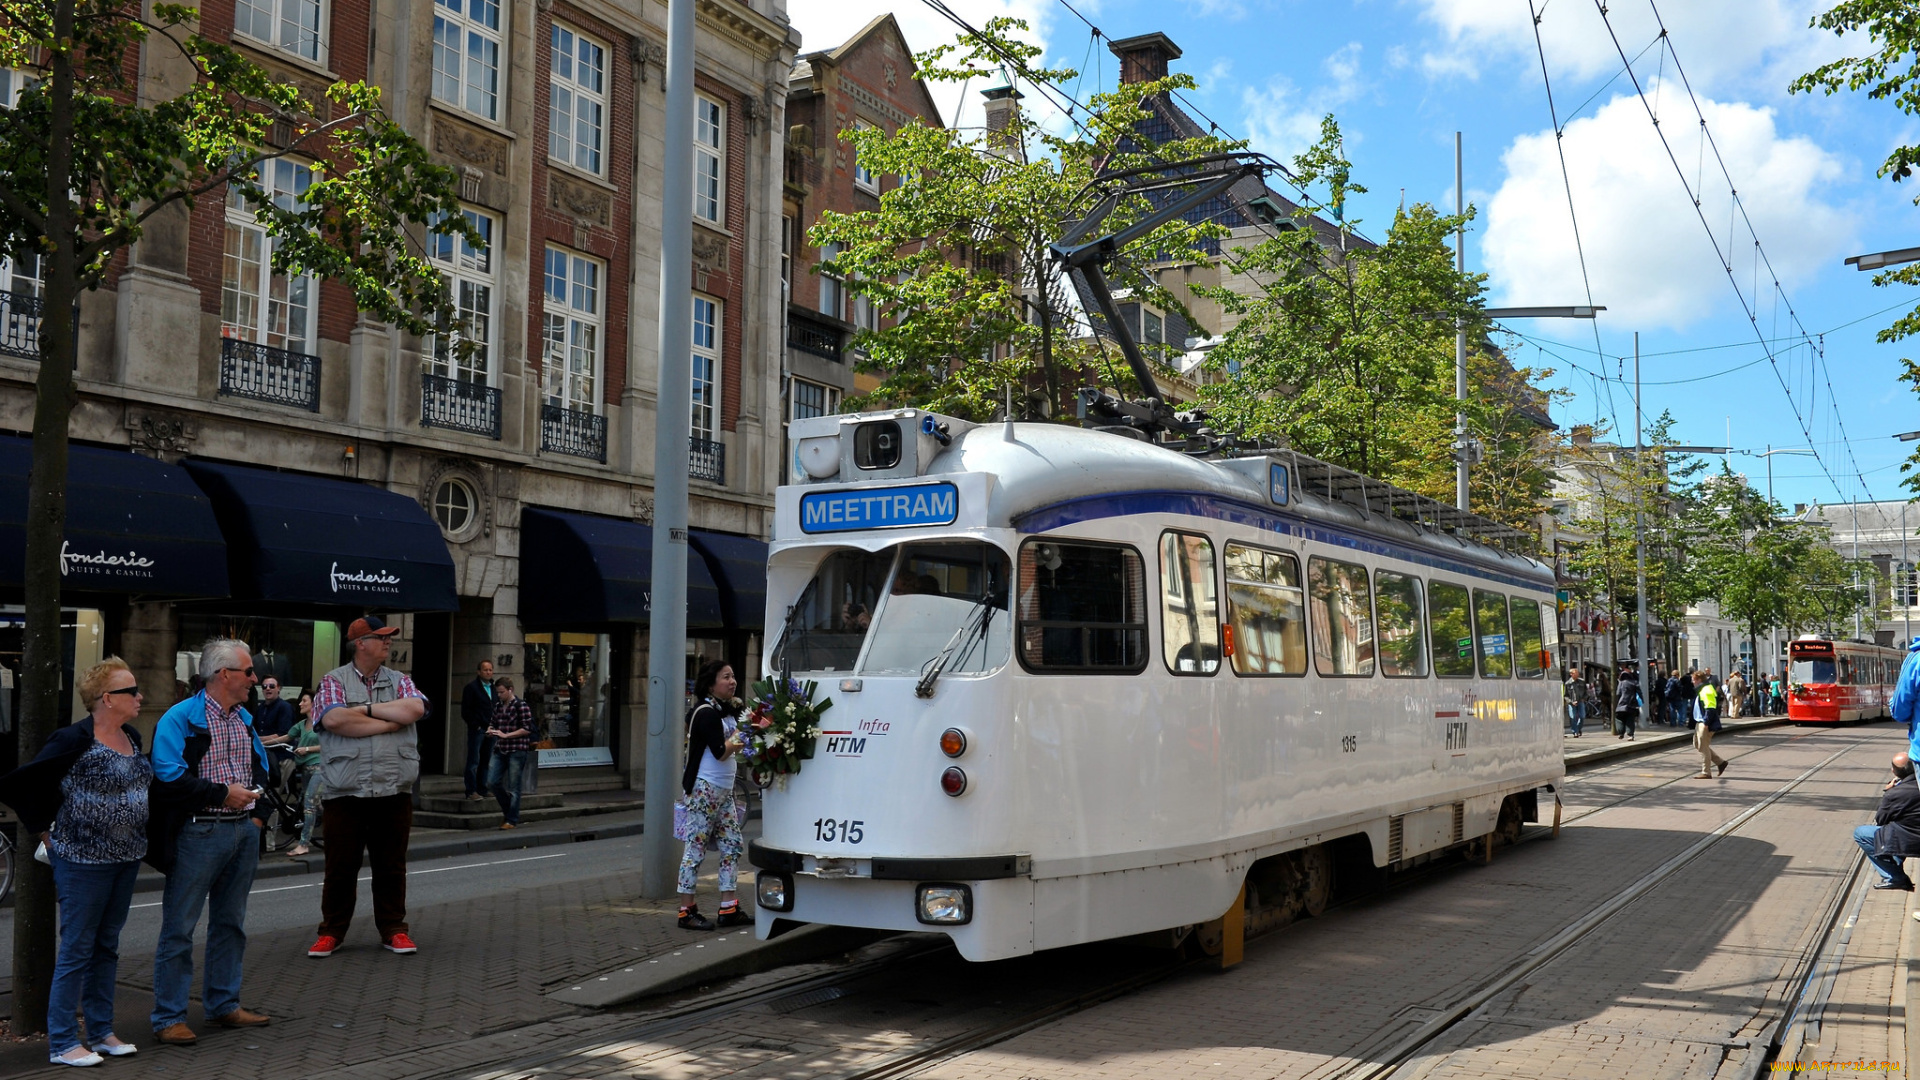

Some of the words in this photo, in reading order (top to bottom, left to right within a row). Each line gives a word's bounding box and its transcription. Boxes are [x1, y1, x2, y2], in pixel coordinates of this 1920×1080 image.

[806, 492, 953, 525] MEETTRAM
[60, 540, 154, 576] fonderie
[70, 565, 100, 574] SUITS
[116, 569, 153, 577] CASUAL
[330, 561, 400, 593] fonderie
[338, 583, 361, 591] SUITS
[858, 718, 890, 733] Infra
[1446, 722, 1468, 750] HTM
[826, 737, 866, 753] HTM
[1341, 735, 1357, 753] 1315
[814, 818, 864, 844] 1315
